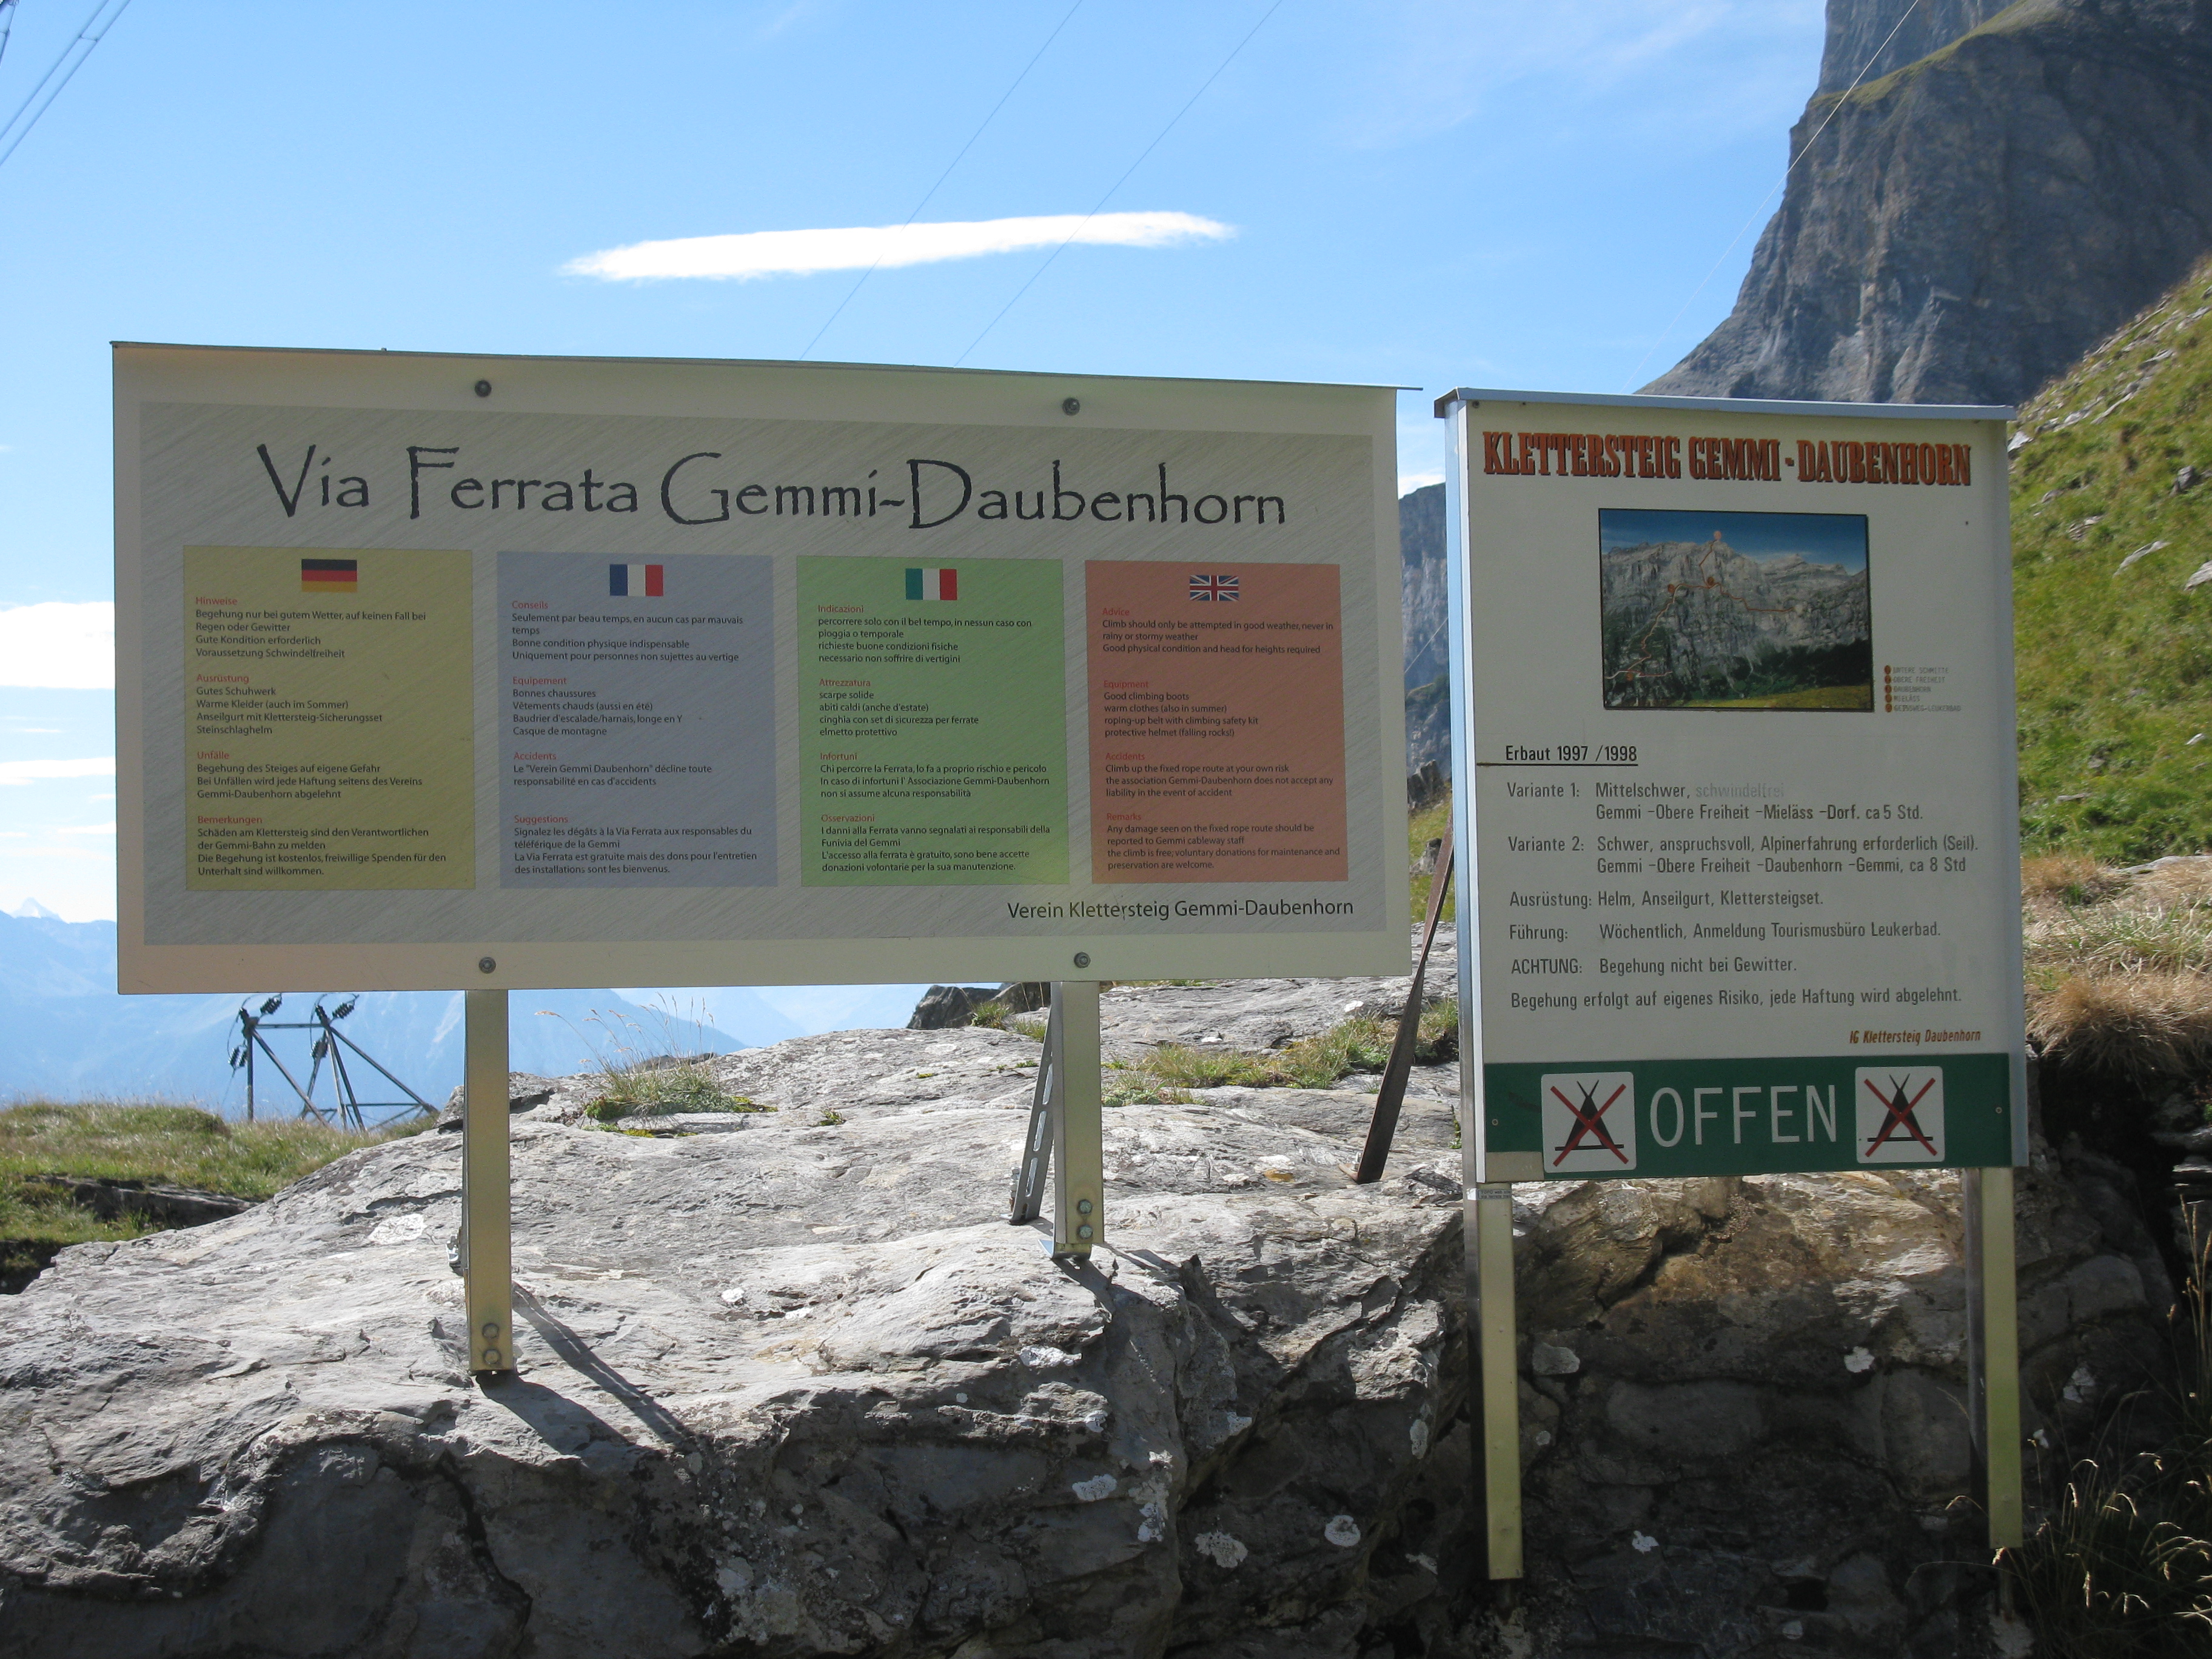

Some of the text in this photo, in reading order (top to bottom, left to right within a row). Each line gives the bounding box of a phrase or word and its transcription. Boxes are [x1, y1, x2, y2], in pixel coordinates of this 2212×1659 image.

[1483, 431, 1681, 480] KLETTERSTEIG
[256, 443, 1285, 529] Via Ferrata Gemmi-Daubenhorn
[196, 597, 238, 606] Hinweise
[512, 600, 548, 609] Conseils
[818, 605, 863, 613] Indicazioni
[1102, 608, 1130, 617] Advice
[196, 622, 290, 633] Regen oder Gewitter
[196, 634, 321, 645] Gute Kondition erforderlich
[819, 629, 850, 639] pioggia
[860, 629, 903, 640] temporale
[1103, 632, 1123, 642] rainy
[1136, 633, 1163, 642] stormy
[1165, 632, 1198, 641] weather
[512, 638, 689, 650] Bonne condition physique indispensable
[819, 641, 958, 651] richieste buone condizioni fisiche
[196, 648, 344, 659] Voraussetzung Schwindelfreiheit
[196, 674, 249, 685] Ausrüstung
[513, 676, 566, 686] Equipement
[819, 679, 871, 687] Attrezzatura
[1104, 680, 1148, 689] Equipment
[196, 686, 276, 695] Gutes Schuhwerk
[513, 688, 596, 698] Bonnes chaussures
[819, 690, 874, 700] scarpe solide
[1104, 691, 1189, 702] Good climbing boots
[197, 712, 382, 724] Anseilgurt mit Klettersteig-Sicherungsset
[197, 725, 272, 736] Steinschlaghelm
[513, 726, 607, 738] Casque de montagne
[820, 727, 897, 737] elmetto protettivo
[1105, 728, 1146, 739] protective
[1148, 728, 1176, 737] helmet
[1179, 728, 1207, 739] (falling
[197, 750, 229, 760] Unfälle
[514, 752, 556, 760] Accidents
[820, 752, 857, 761] Infortuni
[1105, 752, 1145, 760] Accidents
[1506, 745, 1550, 762] Erbaut
[1557, 745, 1589, 762] 1997
[514, 777, 575, 788] responsabilité
[607, 777, 656, 786] d'accidents
[197, 789, 341, 800] Gemmi-Daubenhorn abgelehnt
[840, 789, 846, 797] si
[882, 789, 910, 797] alcuna
[913, 789, 971, 799] responsabilità
[1507, 782, 1564, 797] Variante
[1570, 782, 1579, 797] 1:
[1596, 782, 1690, 799] Mittelschwer,
[1107, 813, 1141, 821] Remarks
[1597, 804, 1641, 820] Gemmi
[1700, 803, 1749, 819] Freiheit
[1866, 808, 1880, 819] ca
[1883, 804, 1891, 820] 5
[1898, 804, 1922, 819] Std.
[198, 816, 262, 826] Bemerkungen
[514, 815, 568, 826] Suggestions
[821, 814, 874, 823] Osservazioni
[822, 838, 900, 847] Funivia del Gemmi
[1508, 834, 1977, 854] Variante 2: Schwer, anspruchsvoll, Alpinerfahrung erforderlich (Seil).
[1108, 860, 1159, 871] preservation
[1176, 860, 1214, 869] welcome.
[1597, 857, 1641, 873] Gemmi
[1701, 857, 1750, 873] Freiheit
[1910, 861, 1923, 872] ca
[1930, 857, 1937, 872] 8
[1945, 857, 1965, 872] Std
[1510, 890, 1823, 910] Ausrüstung: Helm, Anseilgurt, Klettersteigset.
[1007, 898, 1353, 921] Verein Klettersteig Gemmi-Daubenhorn
[1510, 921, 1940, 943] Führung: Wöchentlich, Anmeldung Tourismusbüro Leukerbad.
[1512, 956, 1796, 977] ACHTUNG: Begehung nicht bei Gewitter.
[1512, 987, 1961, 1011] Begehung erfolgt auf eigenes Risiko, jede Haftung wird abgelehnt.
[1850, 1029, 1980, 1046] IG Klettersteig Daubenhorn
[1650, 1085, 1836, 1148] OFFEN
